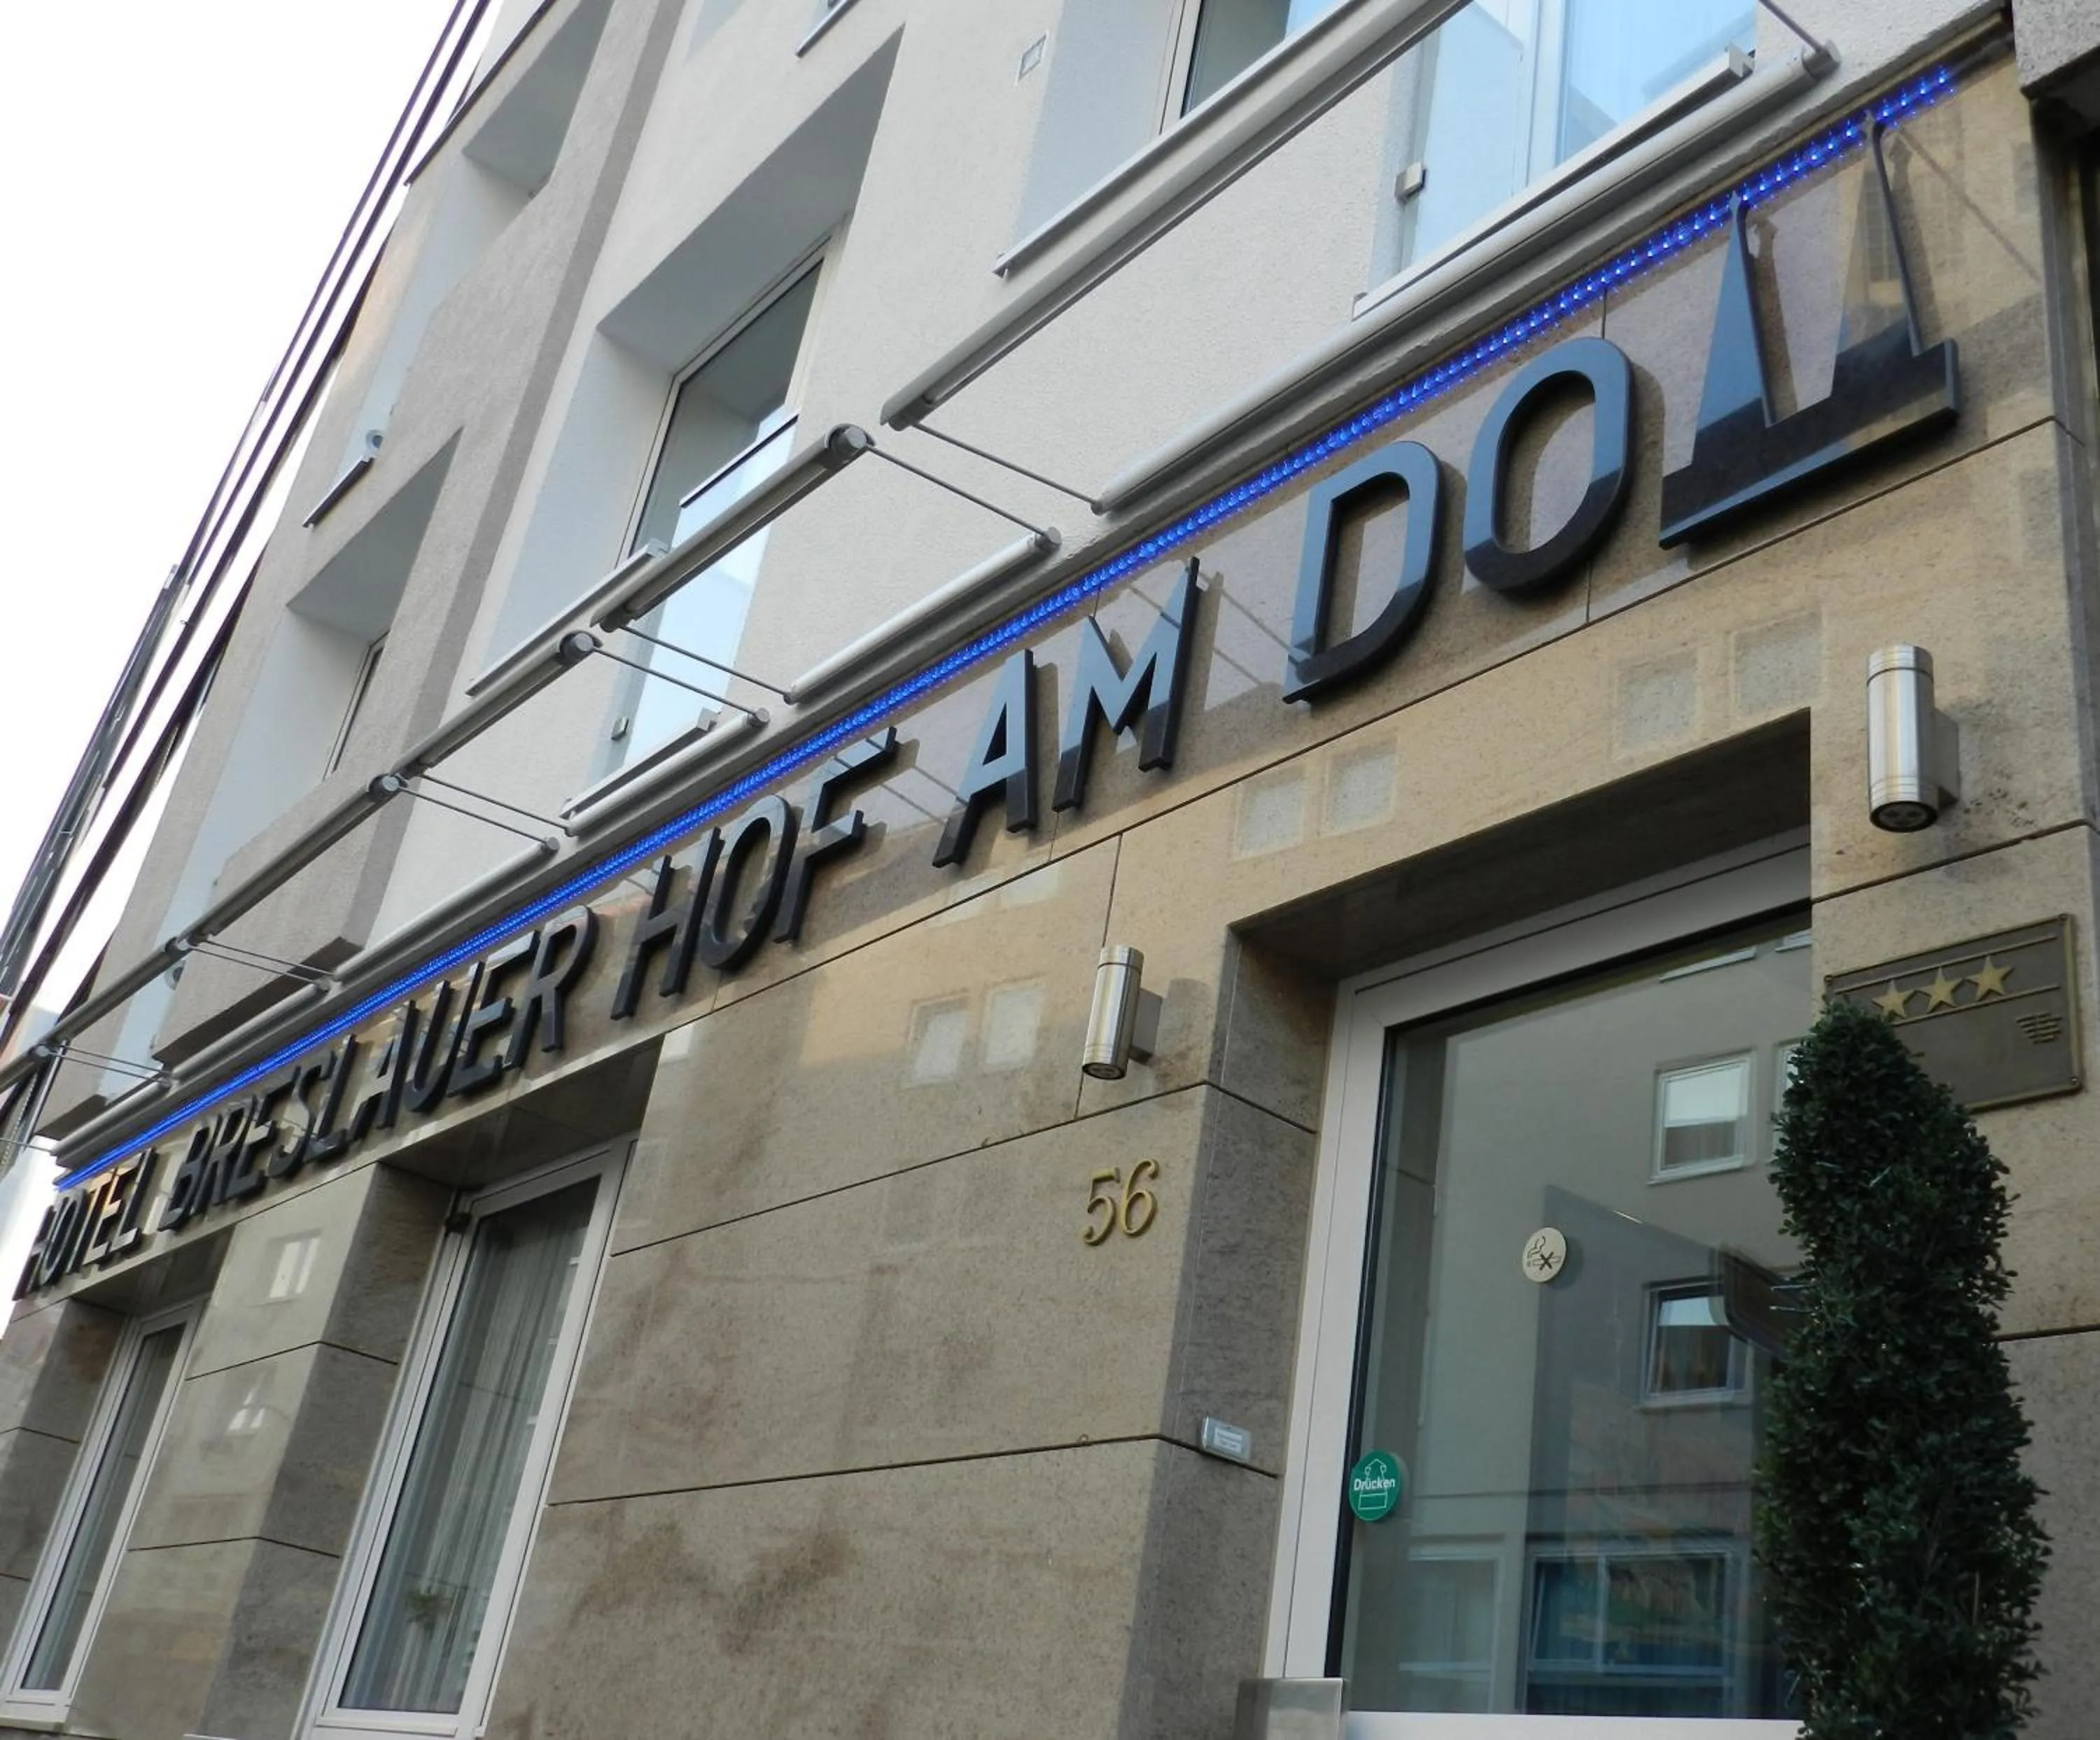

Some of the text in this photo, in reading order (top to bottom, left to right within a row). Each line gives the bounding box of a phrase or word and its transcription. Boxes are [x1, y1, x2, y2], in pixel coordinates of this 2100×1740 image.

[13, 1146, 158, 1300] HOTEL
[158, 905, 600, 1233] BRESLAUER
[610, 726, 897, 1021] HOF
[932, 556, 1199, 869] AM
[1081, 1159, 1159, 1246] 56
[1353, 1477, 1395, 1491] Drücken
